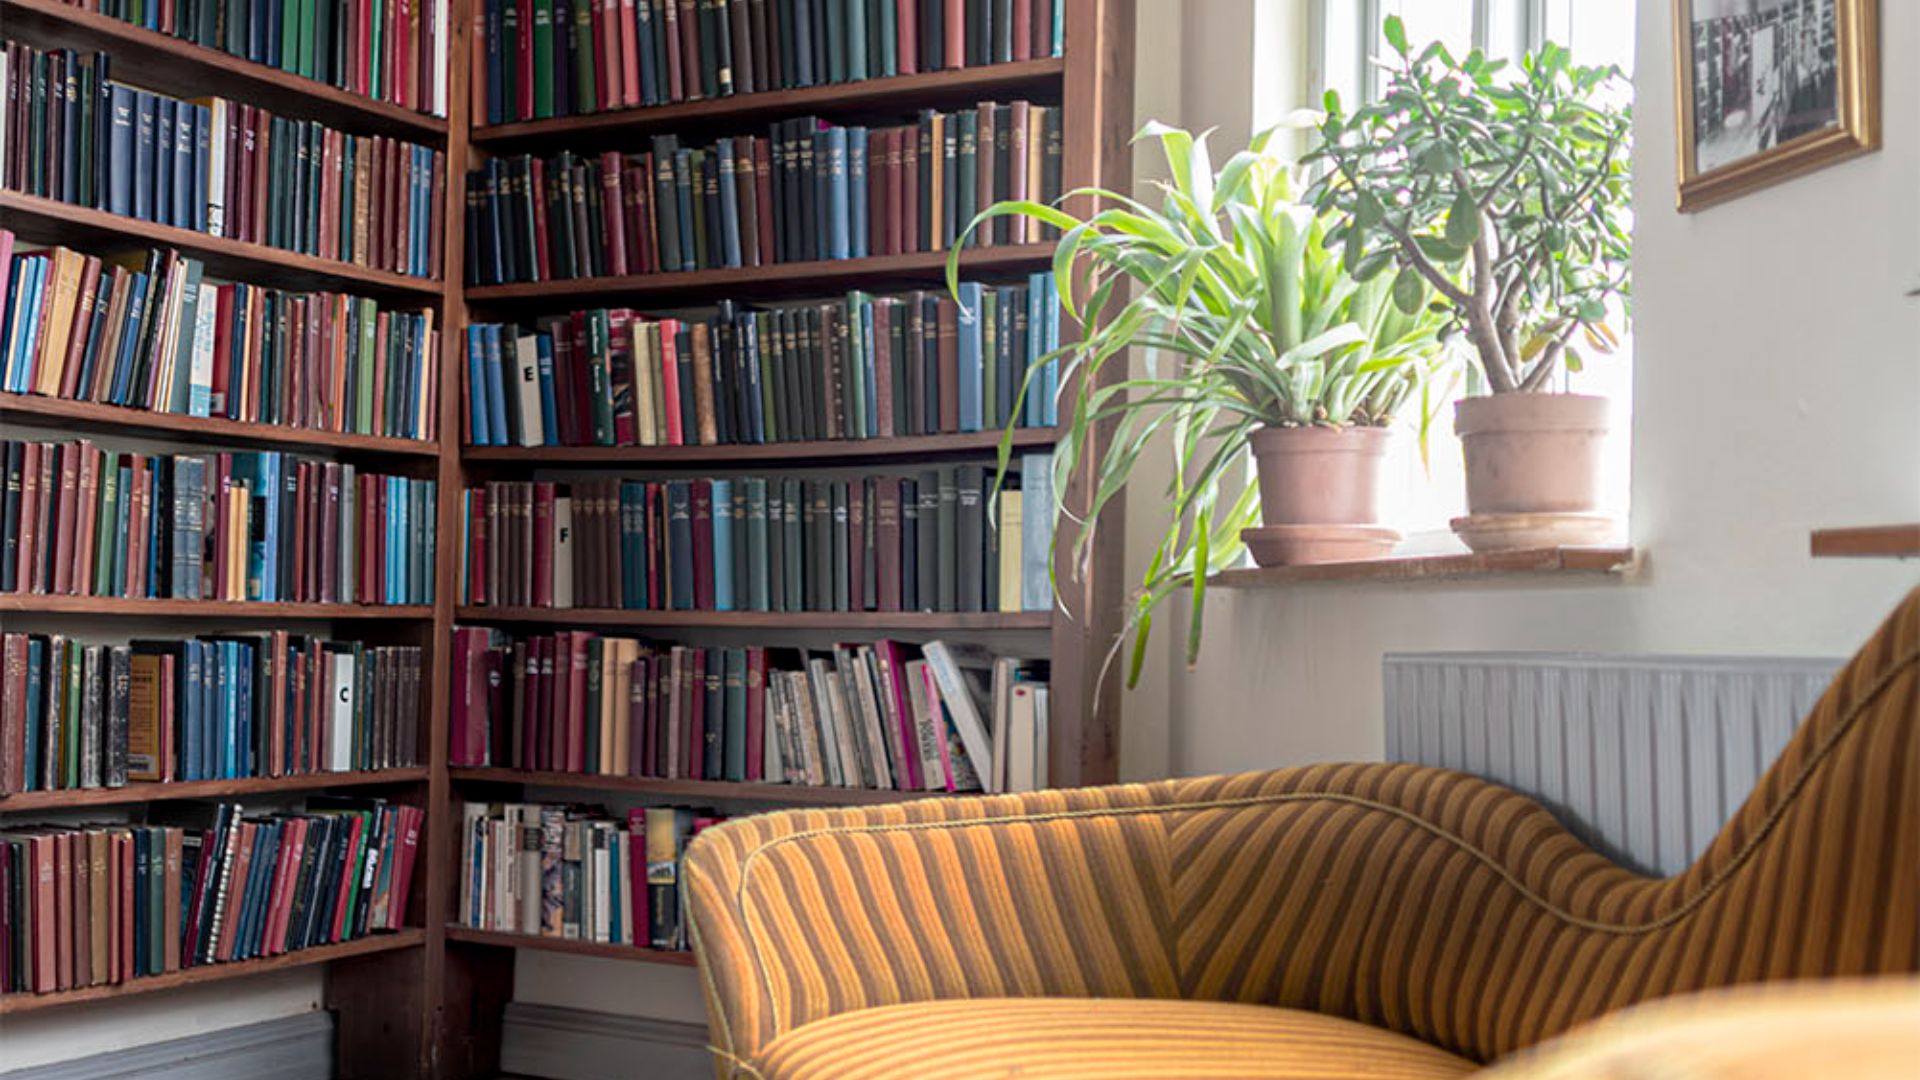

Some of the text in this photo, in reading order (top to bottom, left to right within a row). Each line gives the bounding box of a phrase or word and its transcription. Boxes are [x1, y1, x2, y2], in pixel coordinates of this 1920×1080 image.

[523, 366, 534, 382] E
[560, 527, 568, 543] F
[339, 687, 349, 703] C
